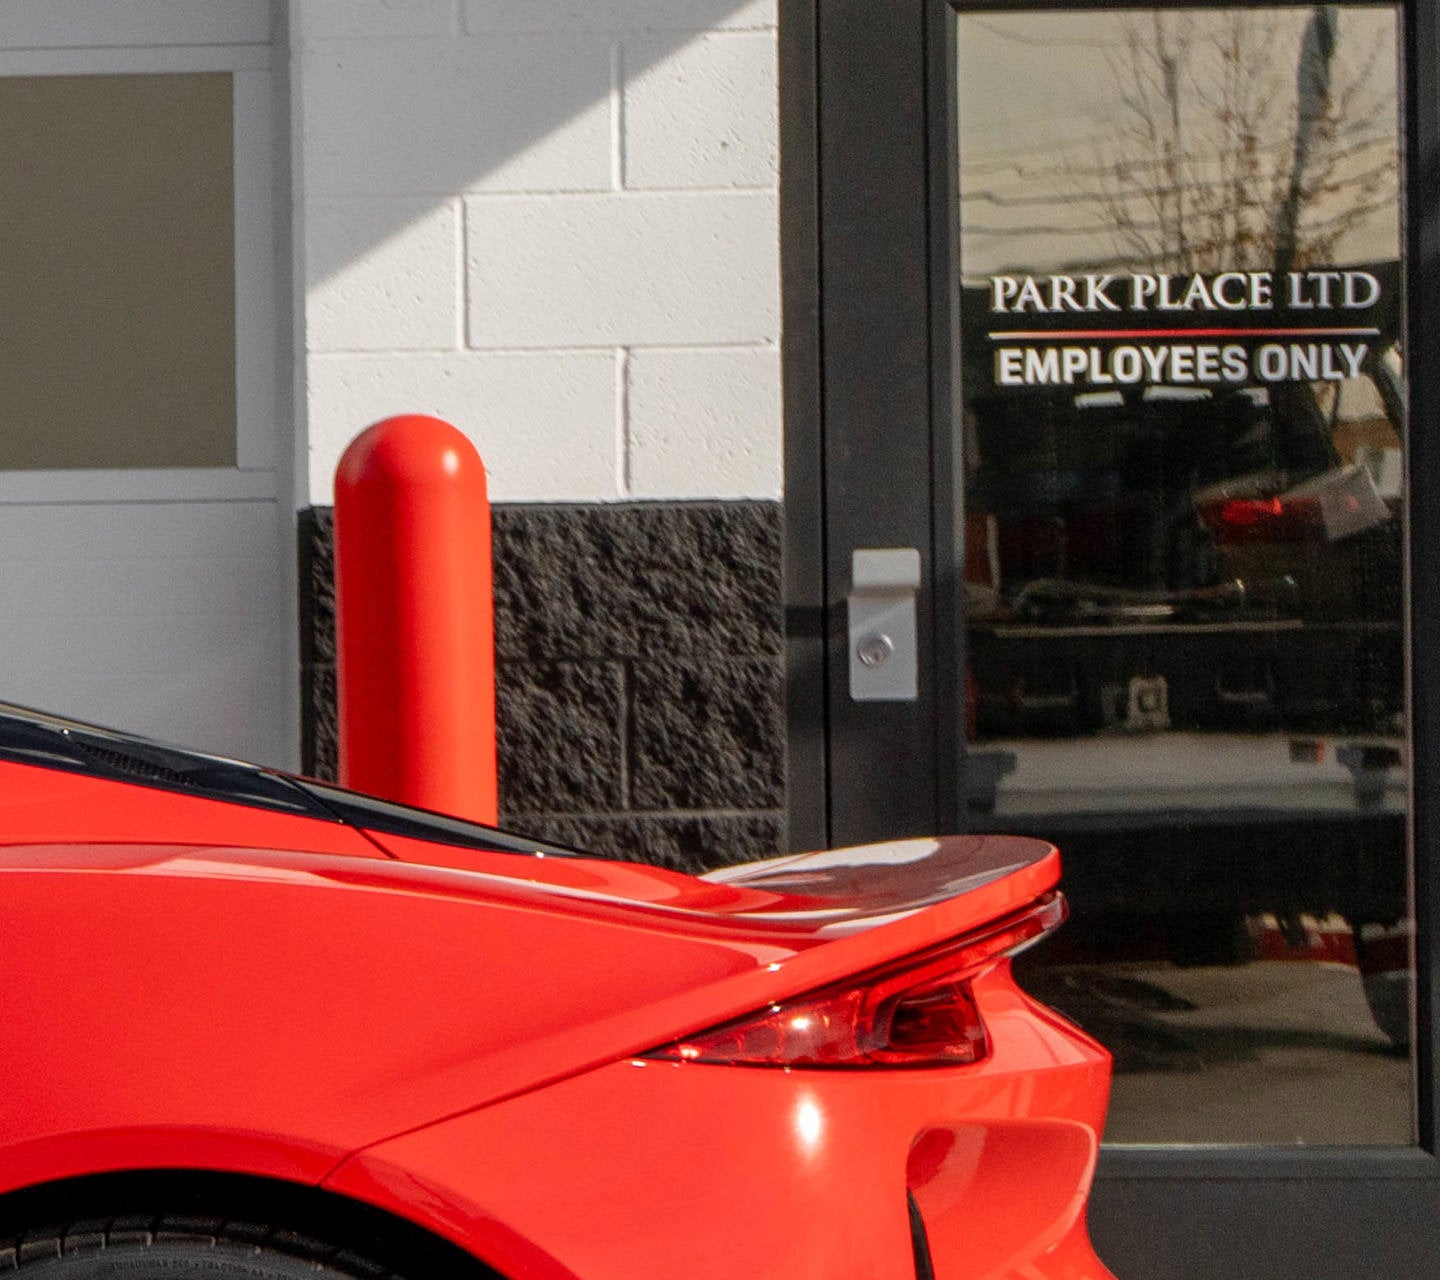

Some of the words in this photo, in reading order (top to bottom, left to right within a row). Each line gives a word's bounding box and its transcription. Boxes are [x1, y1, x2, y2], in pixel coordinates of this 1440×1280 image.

[992, 275, 1121, 313] PARK
[1131, 272, 1274, 312] PLACE
[1287, 272, 1379, 309] LTD
[999, 344, 1248, 384] EMPLOYEES
[1260, 343, 1368, 381] ONLY
